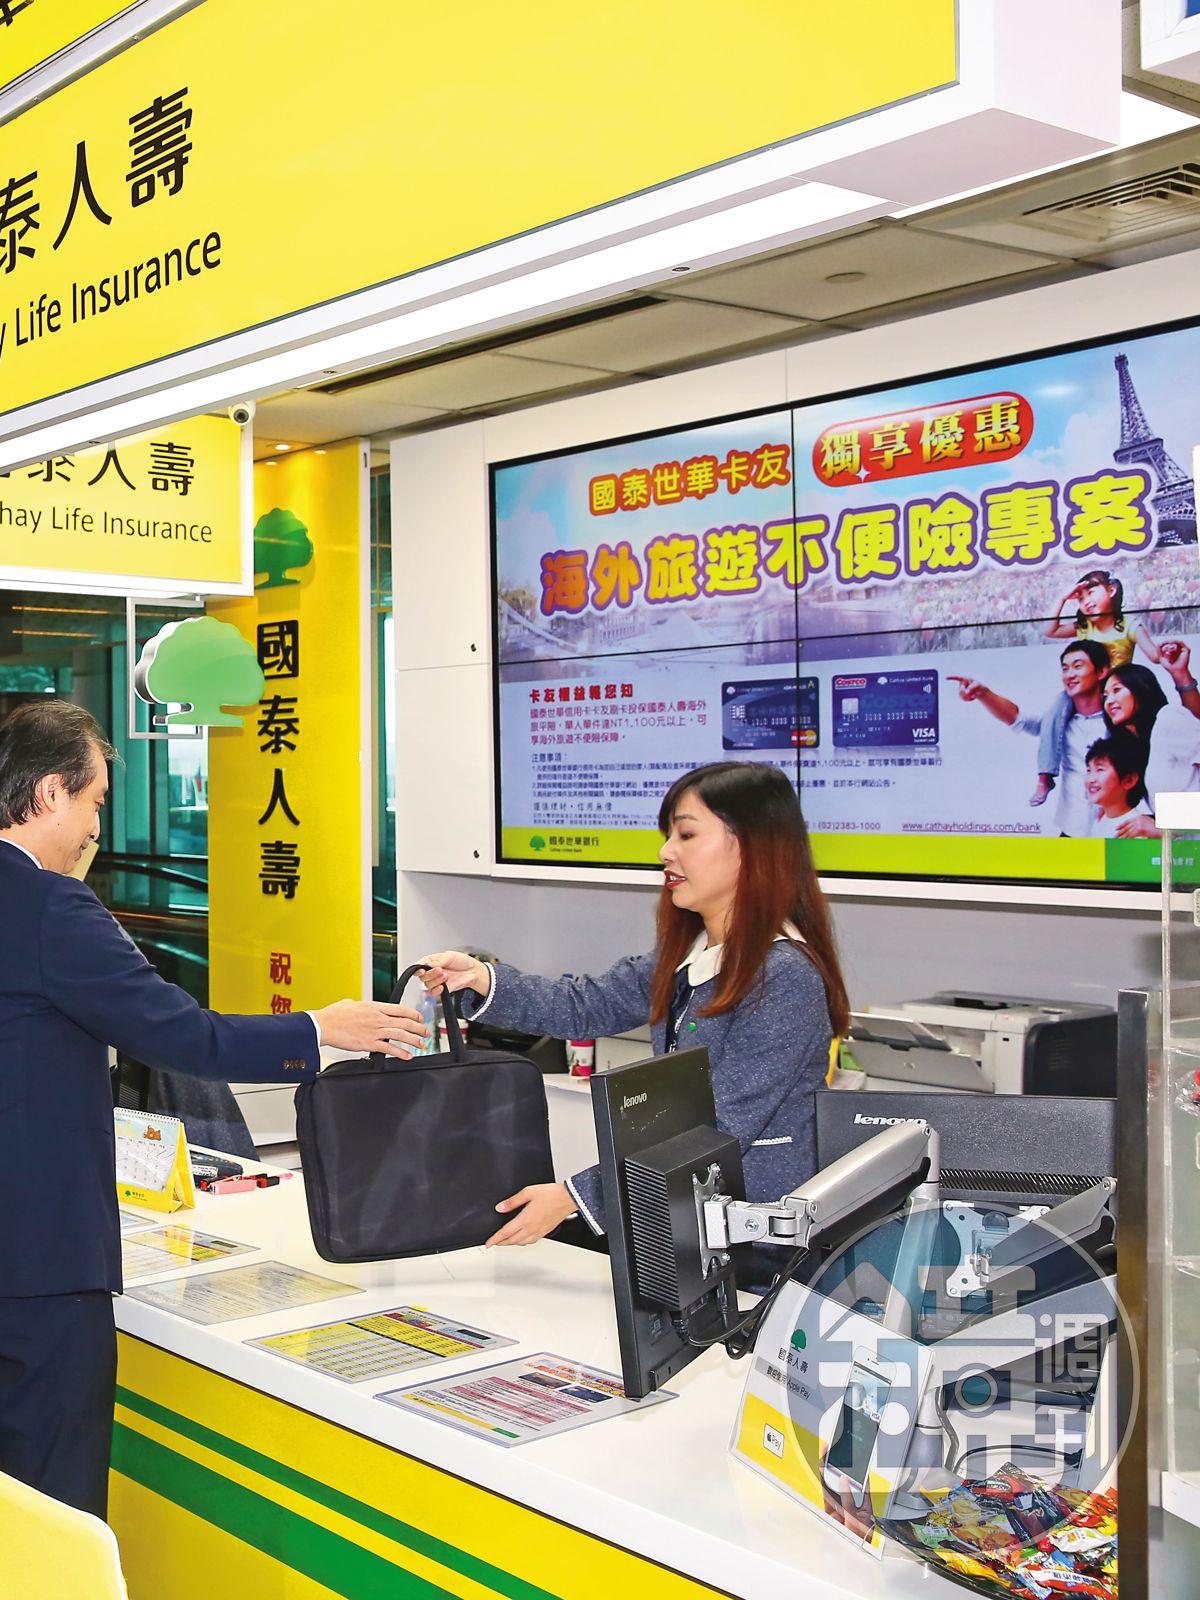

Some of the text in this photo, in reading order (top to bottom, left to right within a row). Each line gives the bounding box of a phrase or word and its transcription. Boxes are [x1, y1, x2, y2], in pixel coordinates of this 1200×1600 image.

[16, 293, 62, 348] Life
[72, 231, 222, 325] Insurance
[819, 396, 1024, 478] 獨享優惠
[590, 444, 791, 514] 國泰世華卡友
[51, 505, 94, 534] Life
[103, 511, 212, 544] Insurance
[540, 470, 1152, 616] 海外旅遊不便險專案
[257, 618, 301, 900] 國泰人壽
[912, 728, 936, 738] VISA
[902, 821, 1041, 833] www.cathayholdings.com/bank
[623, 1092, 647, 1108] lenovo
[800, 1386, 811, 1400] Pay
